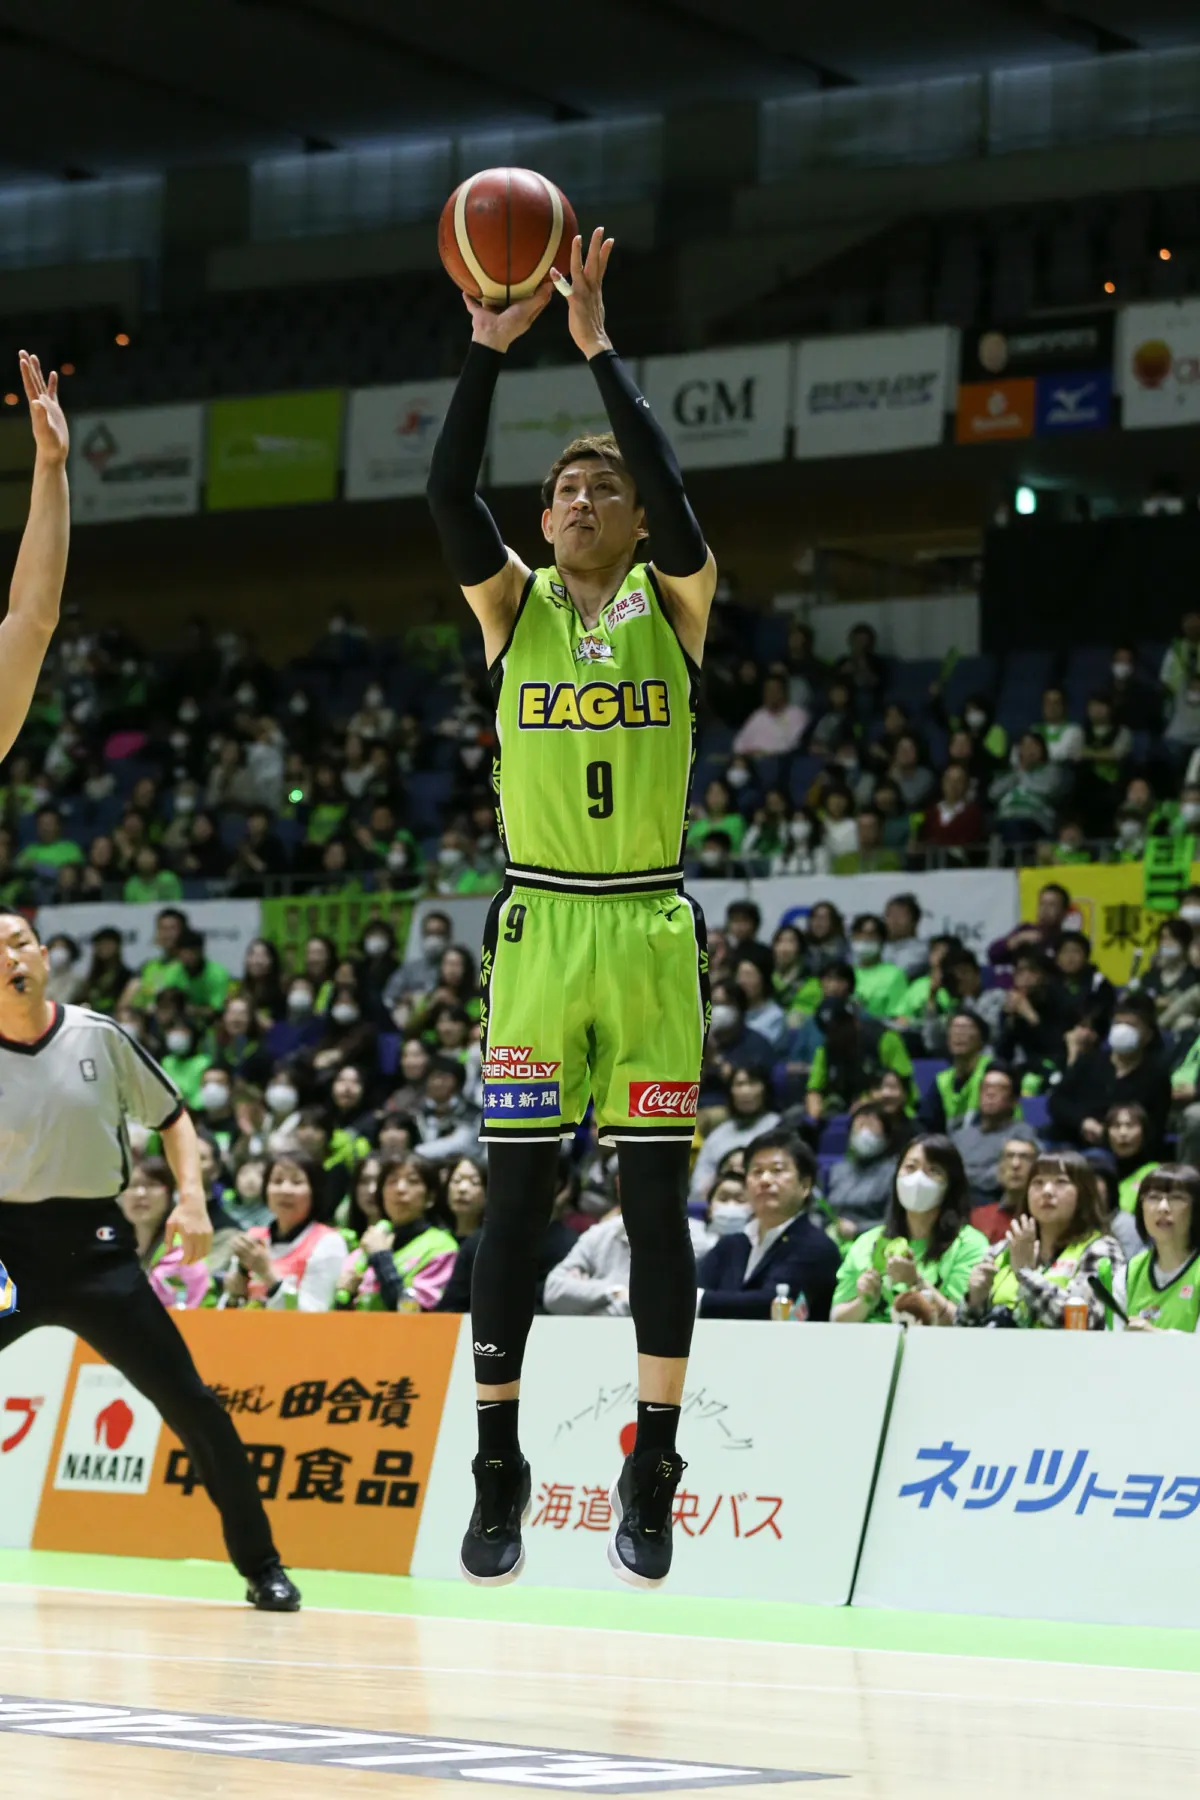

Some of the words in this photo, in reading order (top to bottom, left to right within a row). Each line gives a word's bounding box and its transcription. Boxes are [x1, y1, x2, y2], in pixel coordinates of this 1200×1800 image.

[672, 374, 757, 427] GM
[519, 680, 671, 730] EAGLE
[586, 760, 614, 819] 9
[504, 903, 527, 943] 9
[489, 1046, 532, 1062] NEW
[279, 1377, 420, 1428] 田舎漬
[62, 1453, 145, 1483] NAKATA
[531, 1483, 783, 1540] 海道央バス
